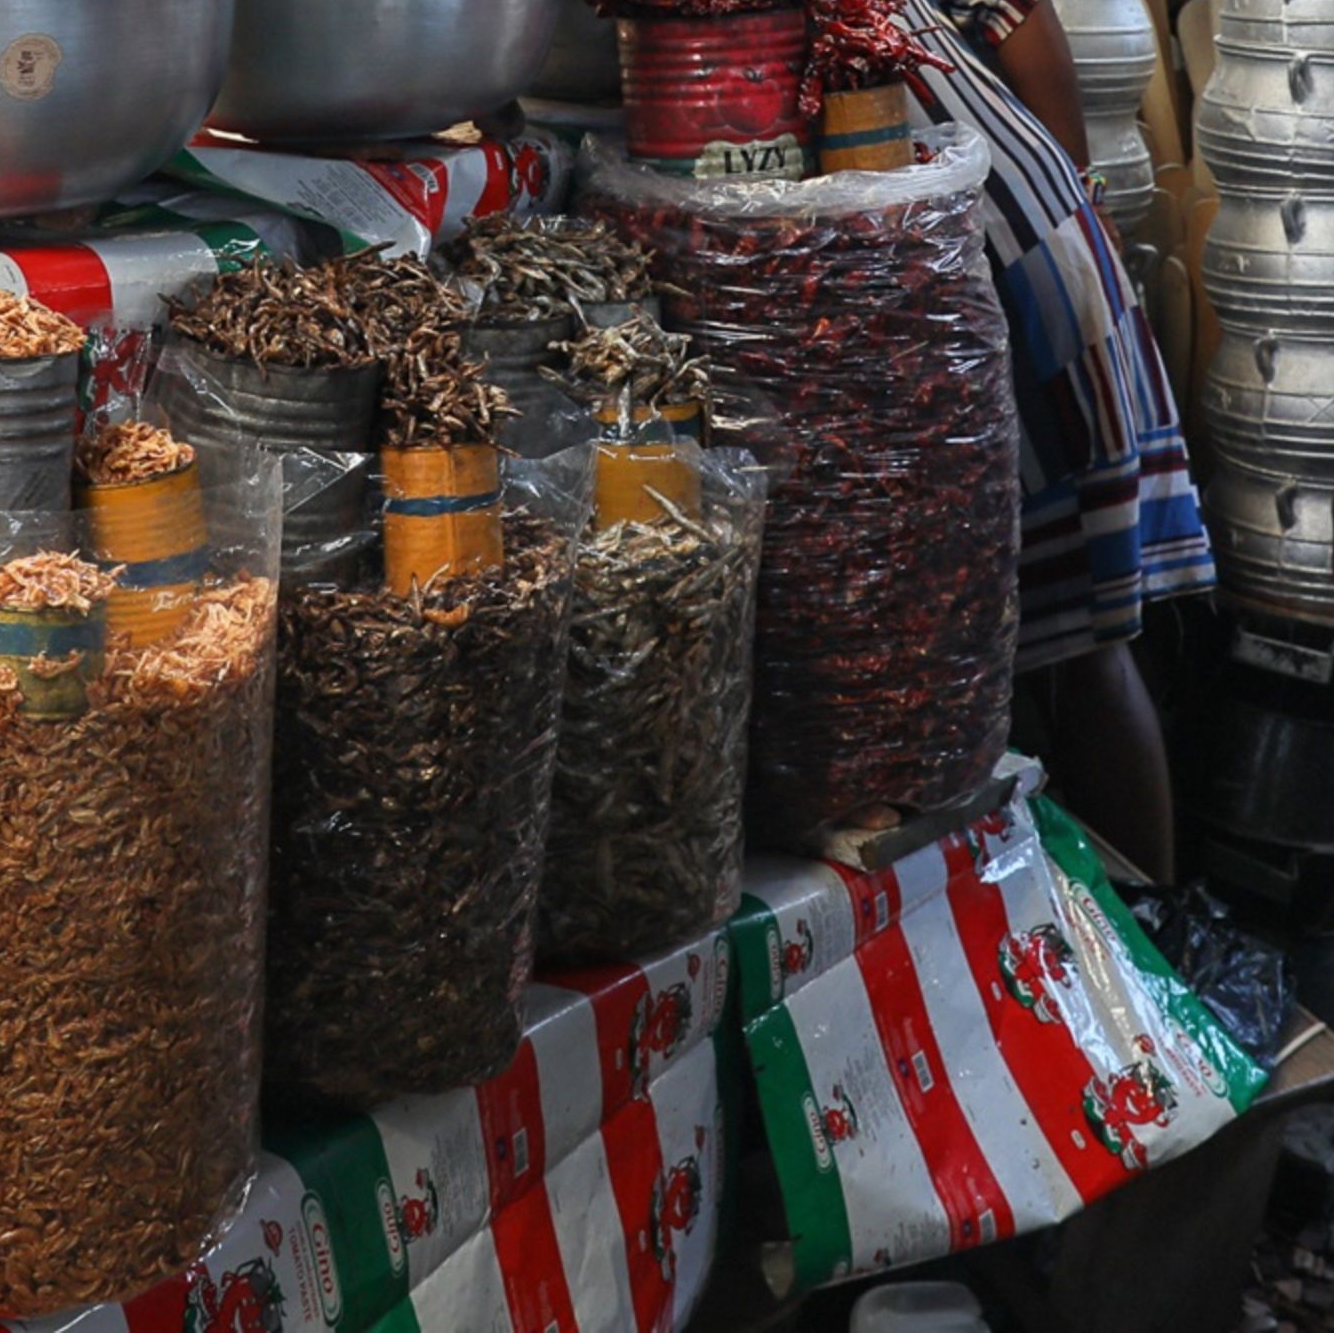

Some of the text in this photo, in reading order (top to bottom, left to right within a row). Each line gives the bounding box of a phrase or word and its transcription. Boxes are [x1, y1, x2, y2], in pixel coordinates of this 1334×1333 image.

[724, 146, 787, 173] LYZY
[288, 1226, 304, 1281] TOMATO
[298, 1281, 313, 1324] PASTE
[312, 1223, 334, 1294] Gino
